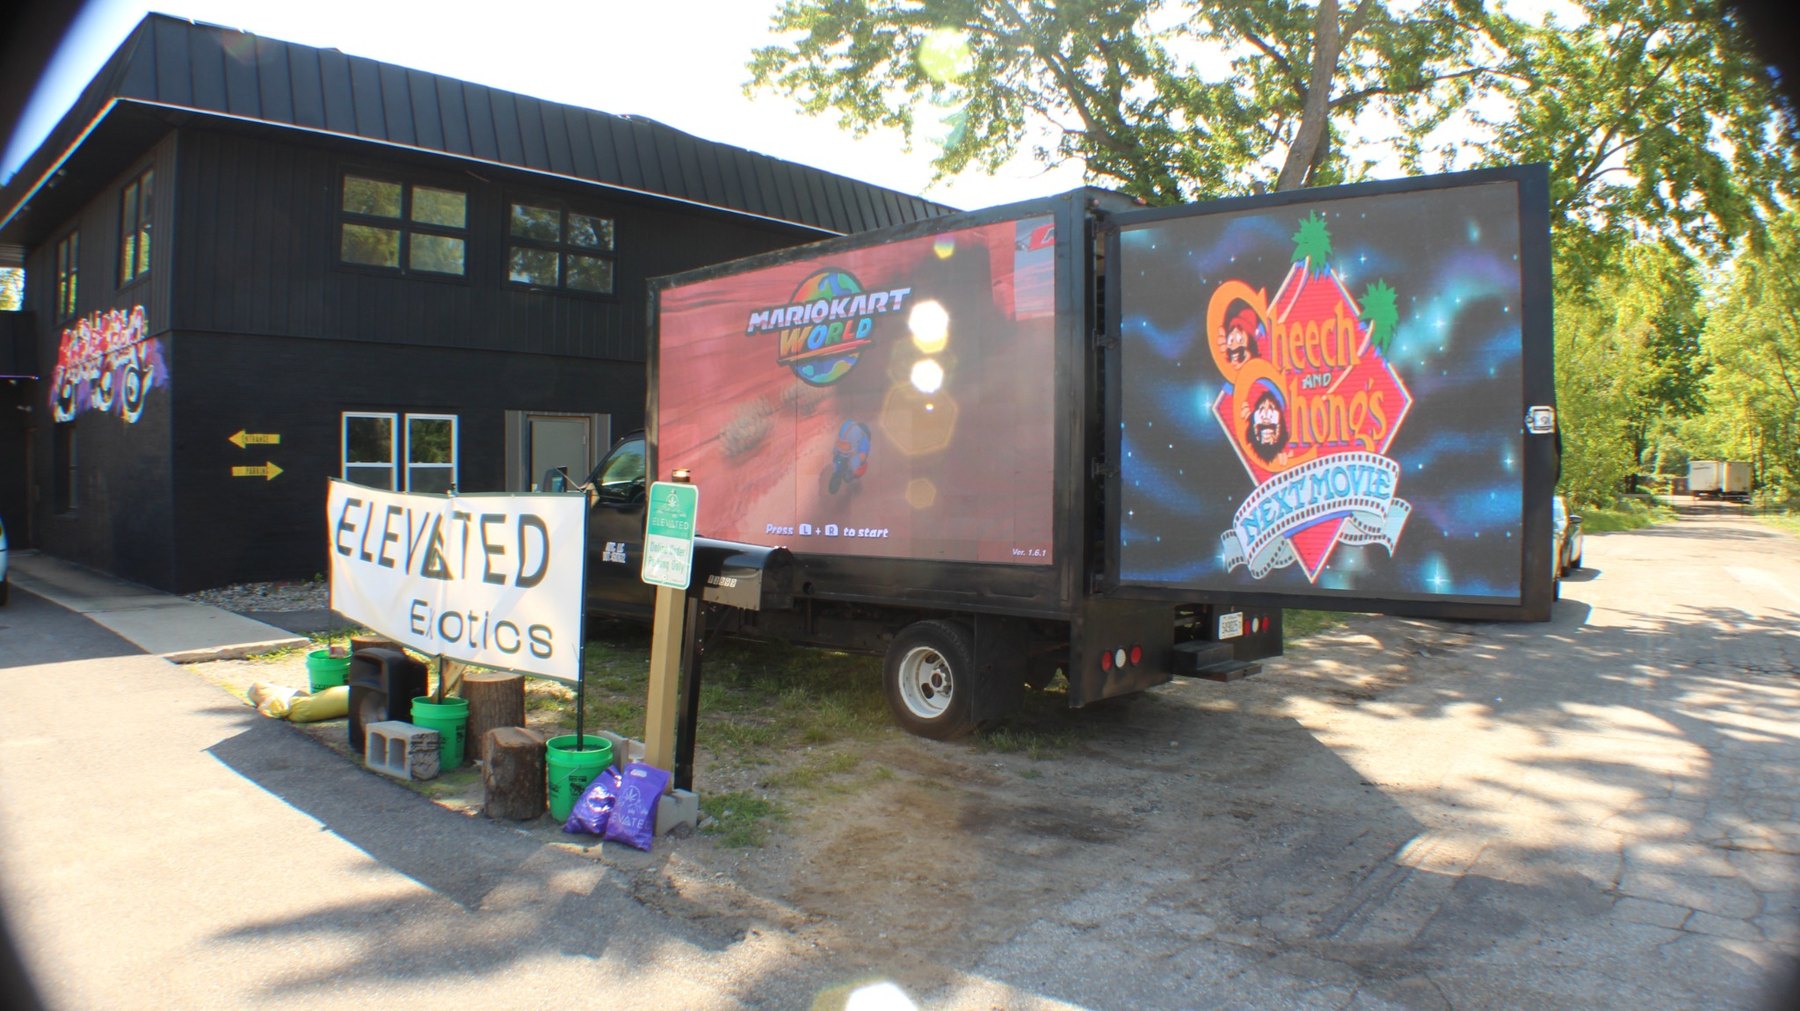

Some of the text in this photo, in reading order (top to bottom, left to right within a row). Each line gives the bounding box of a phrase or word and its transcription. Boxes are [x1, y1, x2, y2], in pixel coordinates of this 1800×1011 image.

[747, 288, 911, 333] MARIO KART
[1207, 280, 1361, 384] Cheech
[780, 317, 872, 357] WORLD
[1302, 373, 1331, 389] AND
[1233, 358, 1387, 473] Chong's
[652, 517, 690, 530] ELEVATED
[1240, 464, 1392, 545] NEXT MOVIE
[336, 497, 550, 589] ELEVATED
[765, 523, 794, 535] Press
[843, 527, 856, 537] to
[857, 528, 889, 538] start
[1012, 548, 1047, 557] Ver. 1.6.1
[411, 598, 553, 659] Exotics
